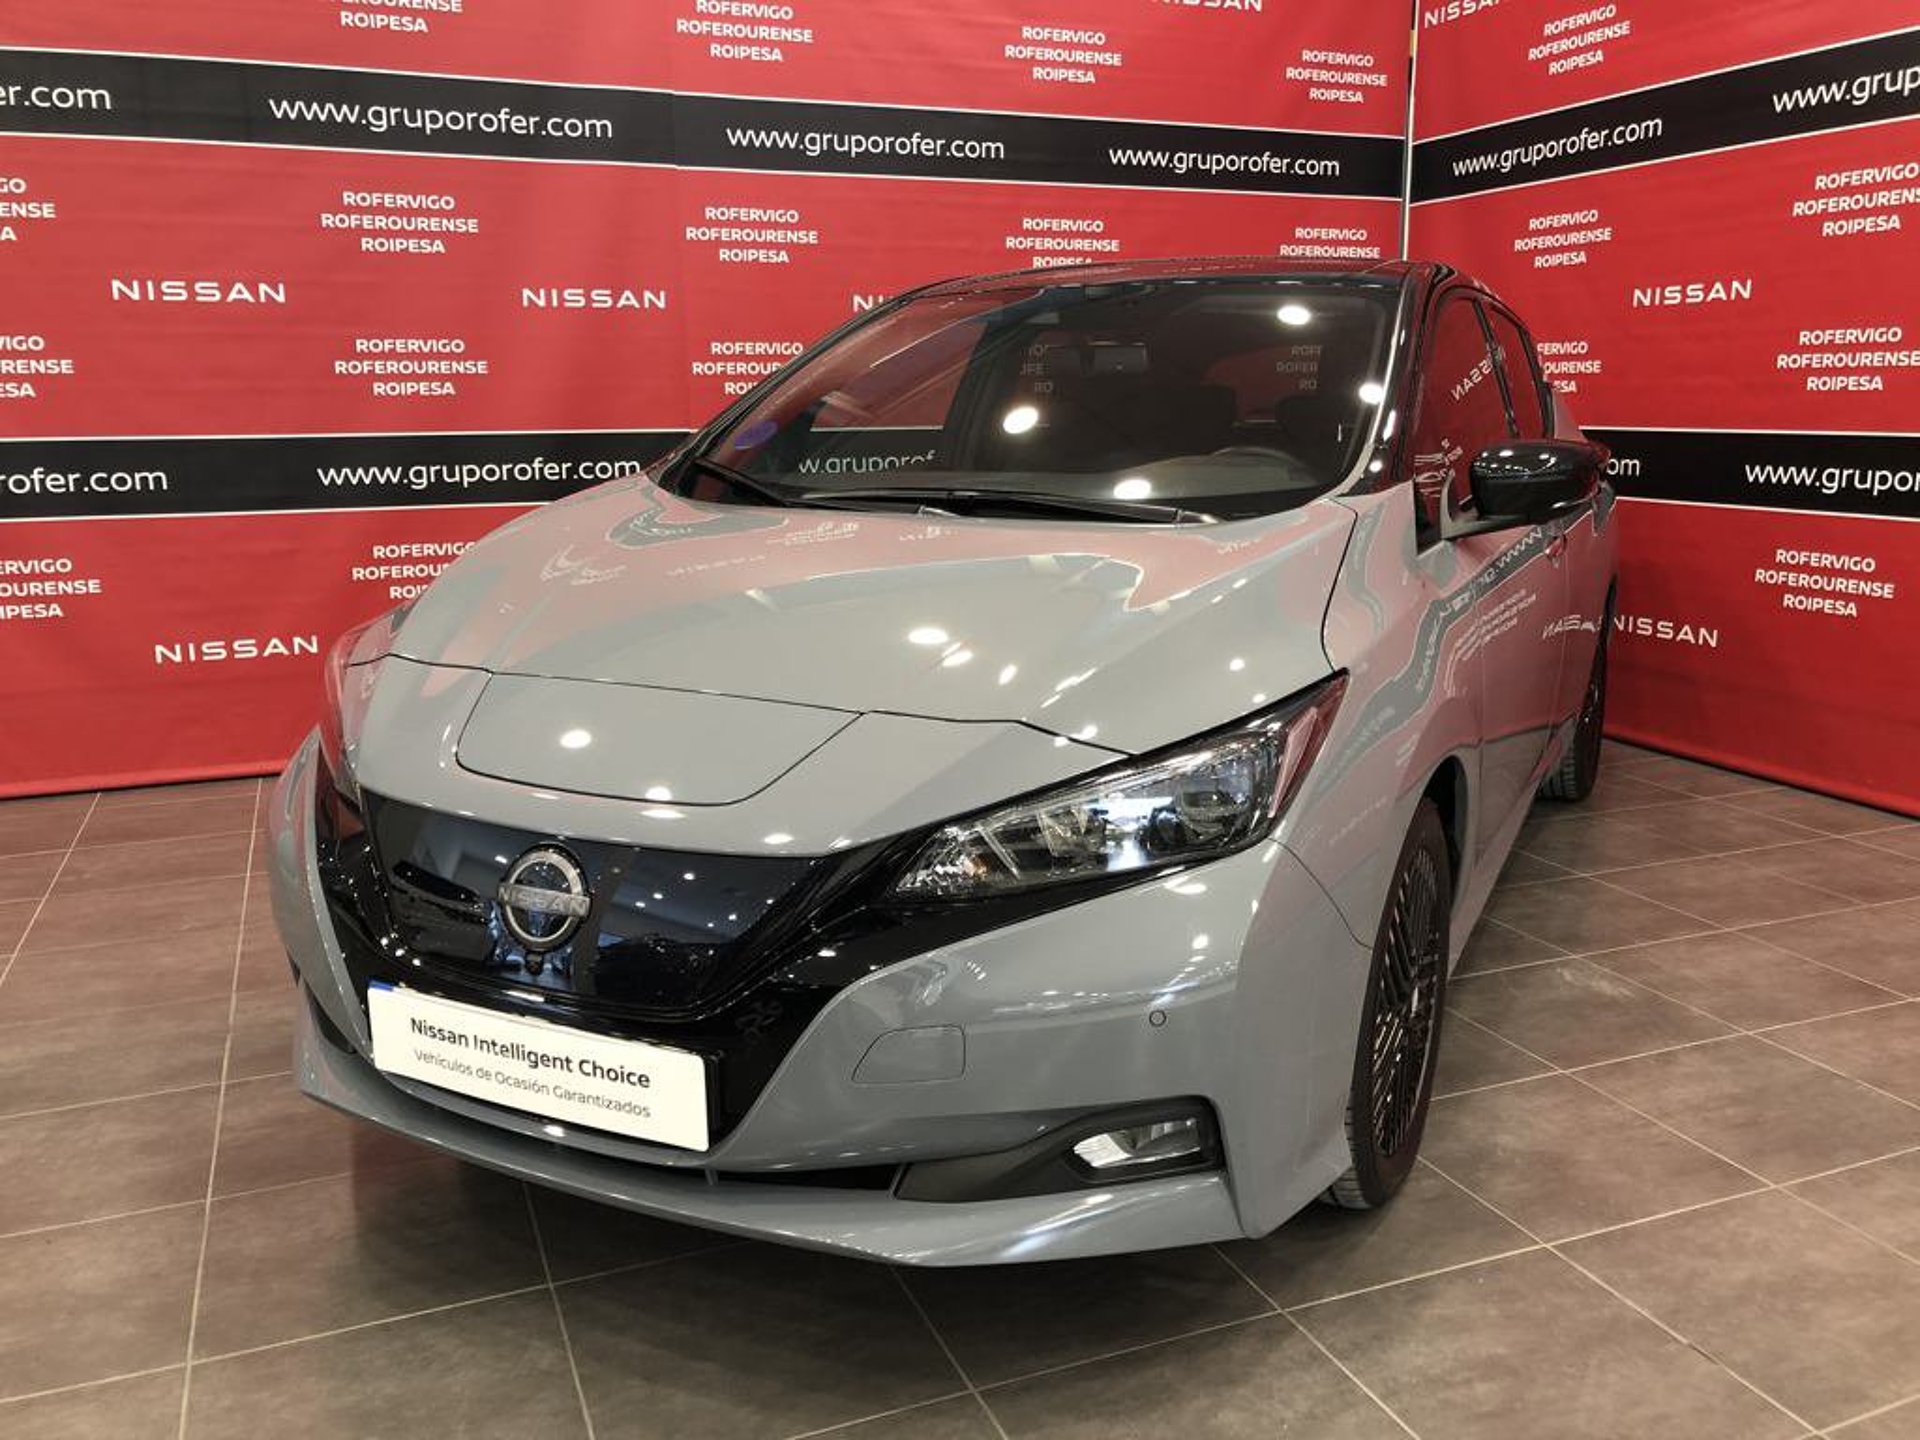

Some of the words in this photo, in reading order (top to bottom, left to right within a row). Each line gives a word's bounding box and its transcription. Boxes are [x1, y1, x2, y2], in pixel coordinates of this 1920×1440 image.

[696, 0, 794, 20] ROFERVIGO
[1543, 4, 1617, 36] ROFERVIGO
[340, 10, 428, 33] ROIPESA
[676, 18, 813, 43] ROFEROURENSE
[1022, 26, 1106, 46] ROFERVIGO
[1528, 20, 1630, 61] ROFEROURENSE
[710, 43, 783, 61] ROIPESA
[1004, 44, 1122, 66] ROFEROURENSE
[1302, 49, 1374, 67] ROFERVIGO
[1548, 49, 1604, 75] ROIPESA
[1032, 66, 1096, 83] ROIPESA
[1285, 66, 1387, 87] ROFEROURENSE
[1309, 87, 1364, 103] ROIPESA
[269, 99, 613, 138] www.gruporofer.com
[726, 127, 1004, 159] www.gruporofer.com
[1452, 118, 1663, 176] www.gruporofer.com
[1108, 148, 1340, 176] www.gruporofer.com
[1815, 162, 1920, 190] ROFERVIGO
[342, 191, 455, 210] ROFERVIGO
[321, 213, 479, 233] ROFEROURENSE
[704, 207, 799, 223] ROFERVIGO
[1022, 218, 1104, 233] ROFERVIGO
[1529, 209, 1599, 231] ROFERVIGO
[1822, 214, 1901, 237] ROIPESA
[685, 226, 818, 244] ROFEROURENSE
[1005, 236, 1119, 252] ROFEROURENSE
[1295, 227, 1368, 241] ROFERVIGO
[1514, 227, 1612, 252] ROFEROURENSE
[361, 237, 446, 254] ROIPESA
[719, 248, 789, 263] ROIPESA
[1279, 244, 1380, 259] ROFEROURENSE
[1534, 250, 1587, 269] ROIPESA
[111, 279, 286, 303] NISSAN
[522, 288, 666, 309] NISSAN
[1633, 279, 1752, 307] NISSAN
[355, 338, 465, 353] ROFERVIGO
[1799, 327, 1902, 346] ROFERVIGO
[711, 342, 804, 357] ROFERVIGO
[334, 360, 488, 375] ROFEROURENSE
[372, 381, 456, 396] ROIPESA
[1806, 375, 1883, 391] ROIPESA
[316, 456, 641, 489] www.gruporofer.com
[1775, 548, 1876, 573] ROFERVIGO
[1754, 568, 1895, 599] ROFEROURENSE
[1783, 593, 1857, 617] ROIPESA
[154, 635, 318, 664] NISSAN
[499, 886, 590, 916] NISSAN
[410, 1017, 469, 1048] Nissan
[473, 1034, 574, 1073] Intelligent
[578, 1058, 650, 1089] Choice
[475, 1066, 493, 1081] de
[494, 1071, 550, 1096] Ocasión
[552, 1084, 652, 1118] Garantizados
